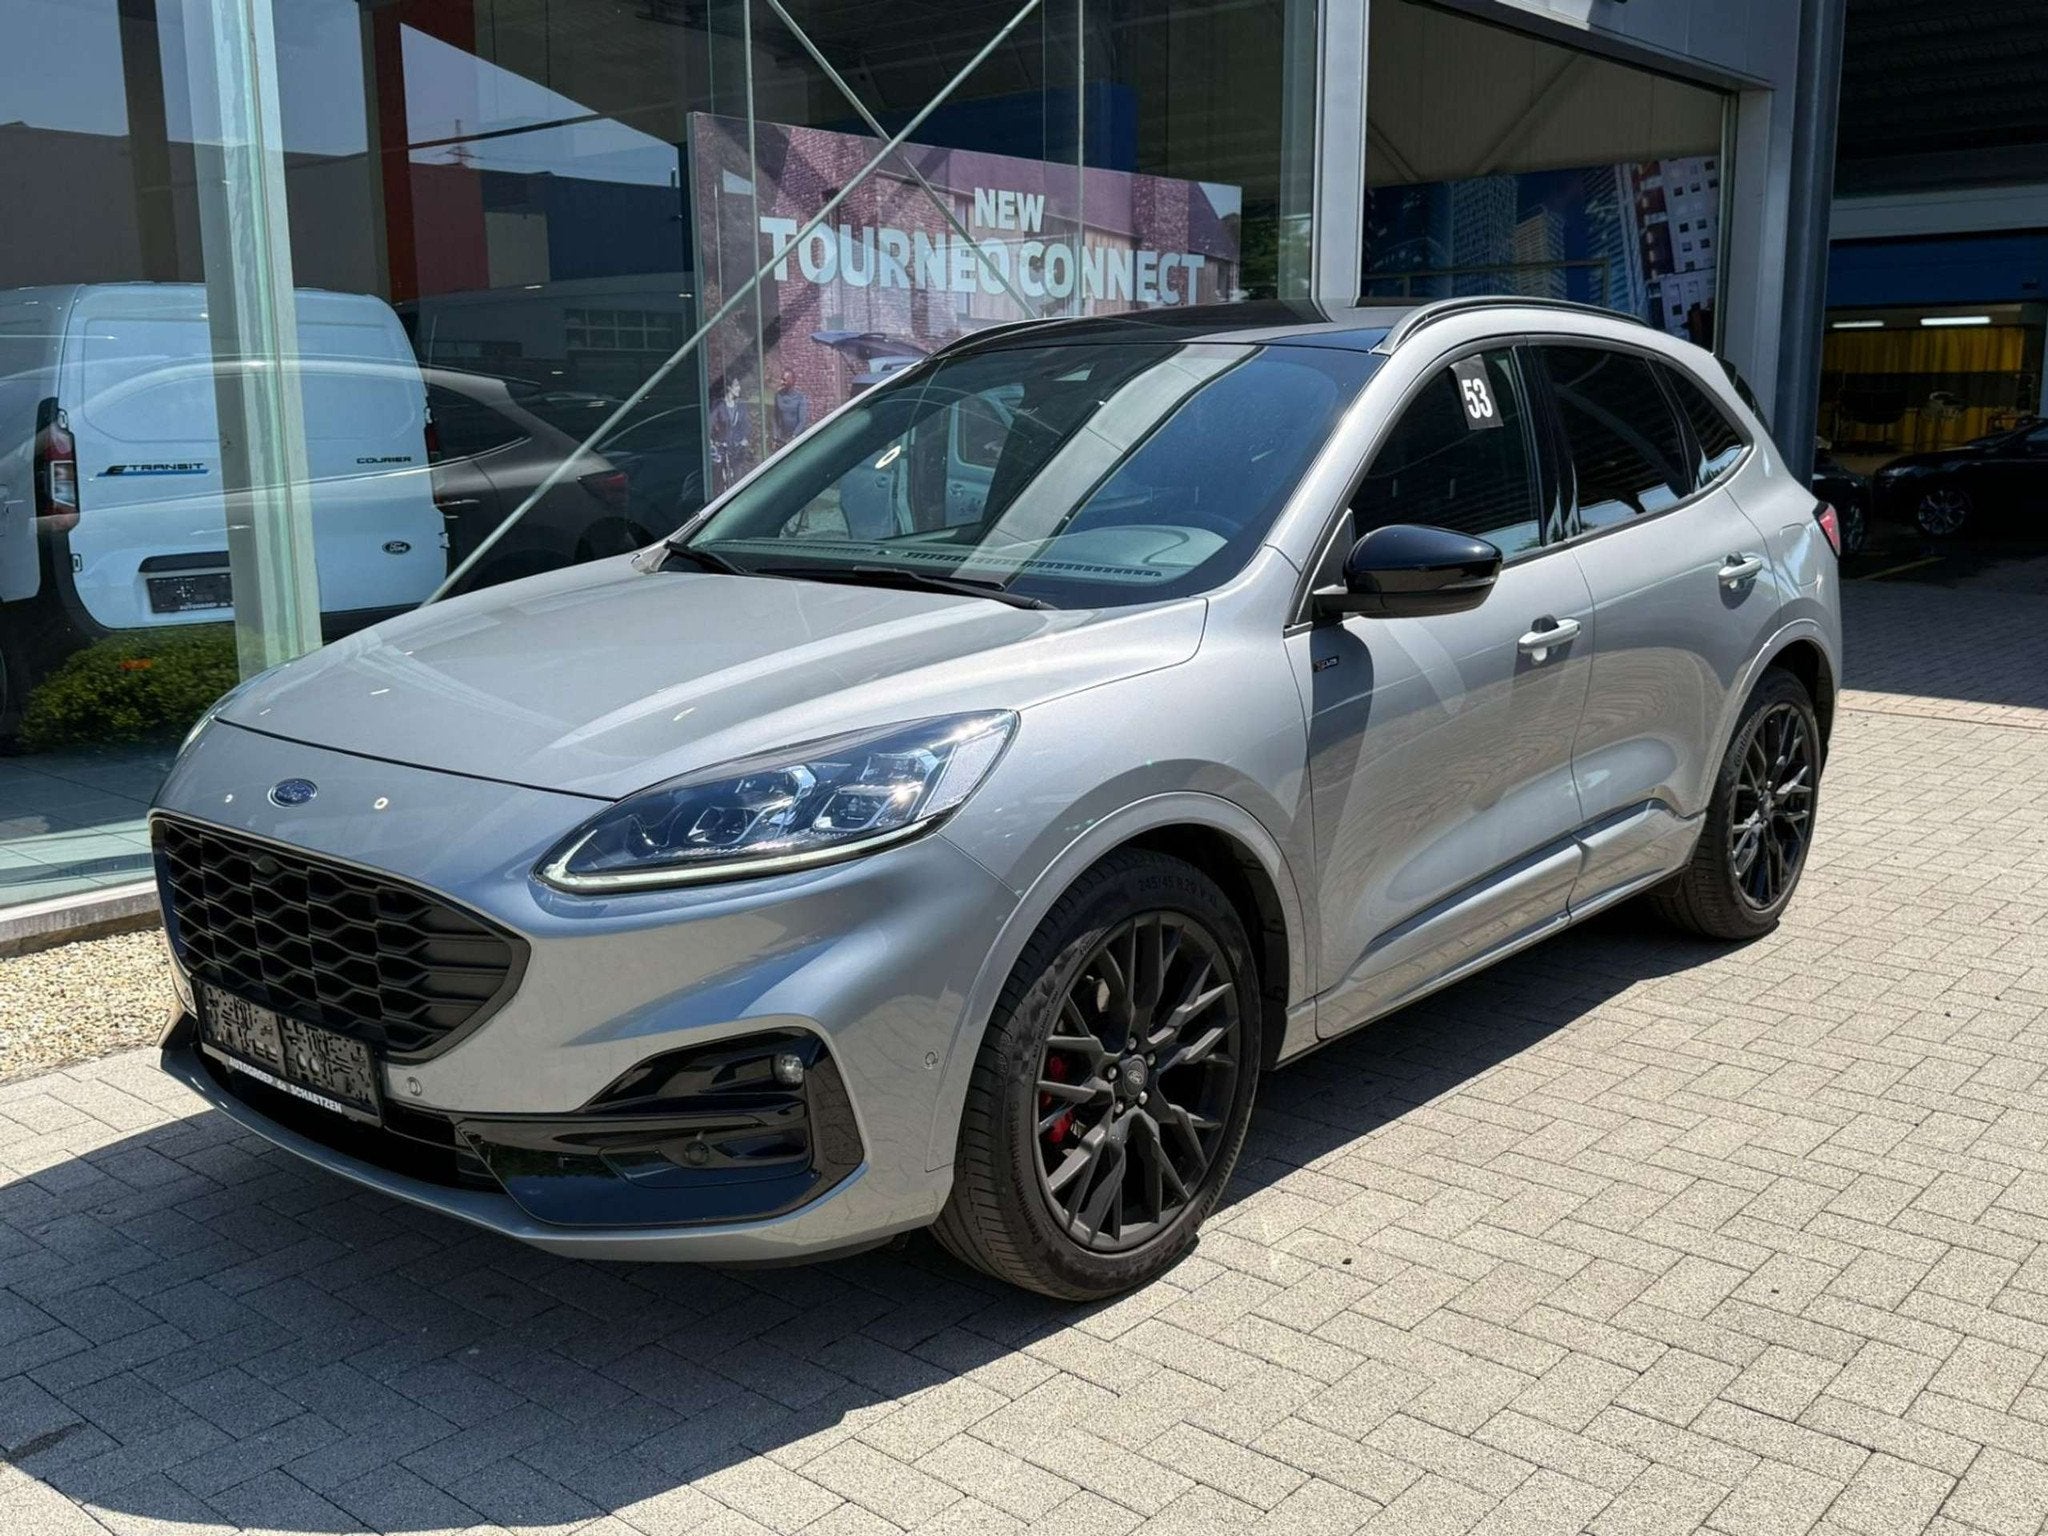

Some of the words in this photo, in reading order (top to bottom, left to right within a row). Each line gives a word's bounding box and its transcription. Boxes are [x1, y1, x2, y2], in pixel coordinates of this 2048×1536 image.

[974, 187, 1045, 232] NEW
[759, 216, 1010, 296] TOURNEO
[1019, 241, 1205, 306] CONNECT
[1462, 378, 1493, 419] 53
[356, 456, 412, 464] COURIER
